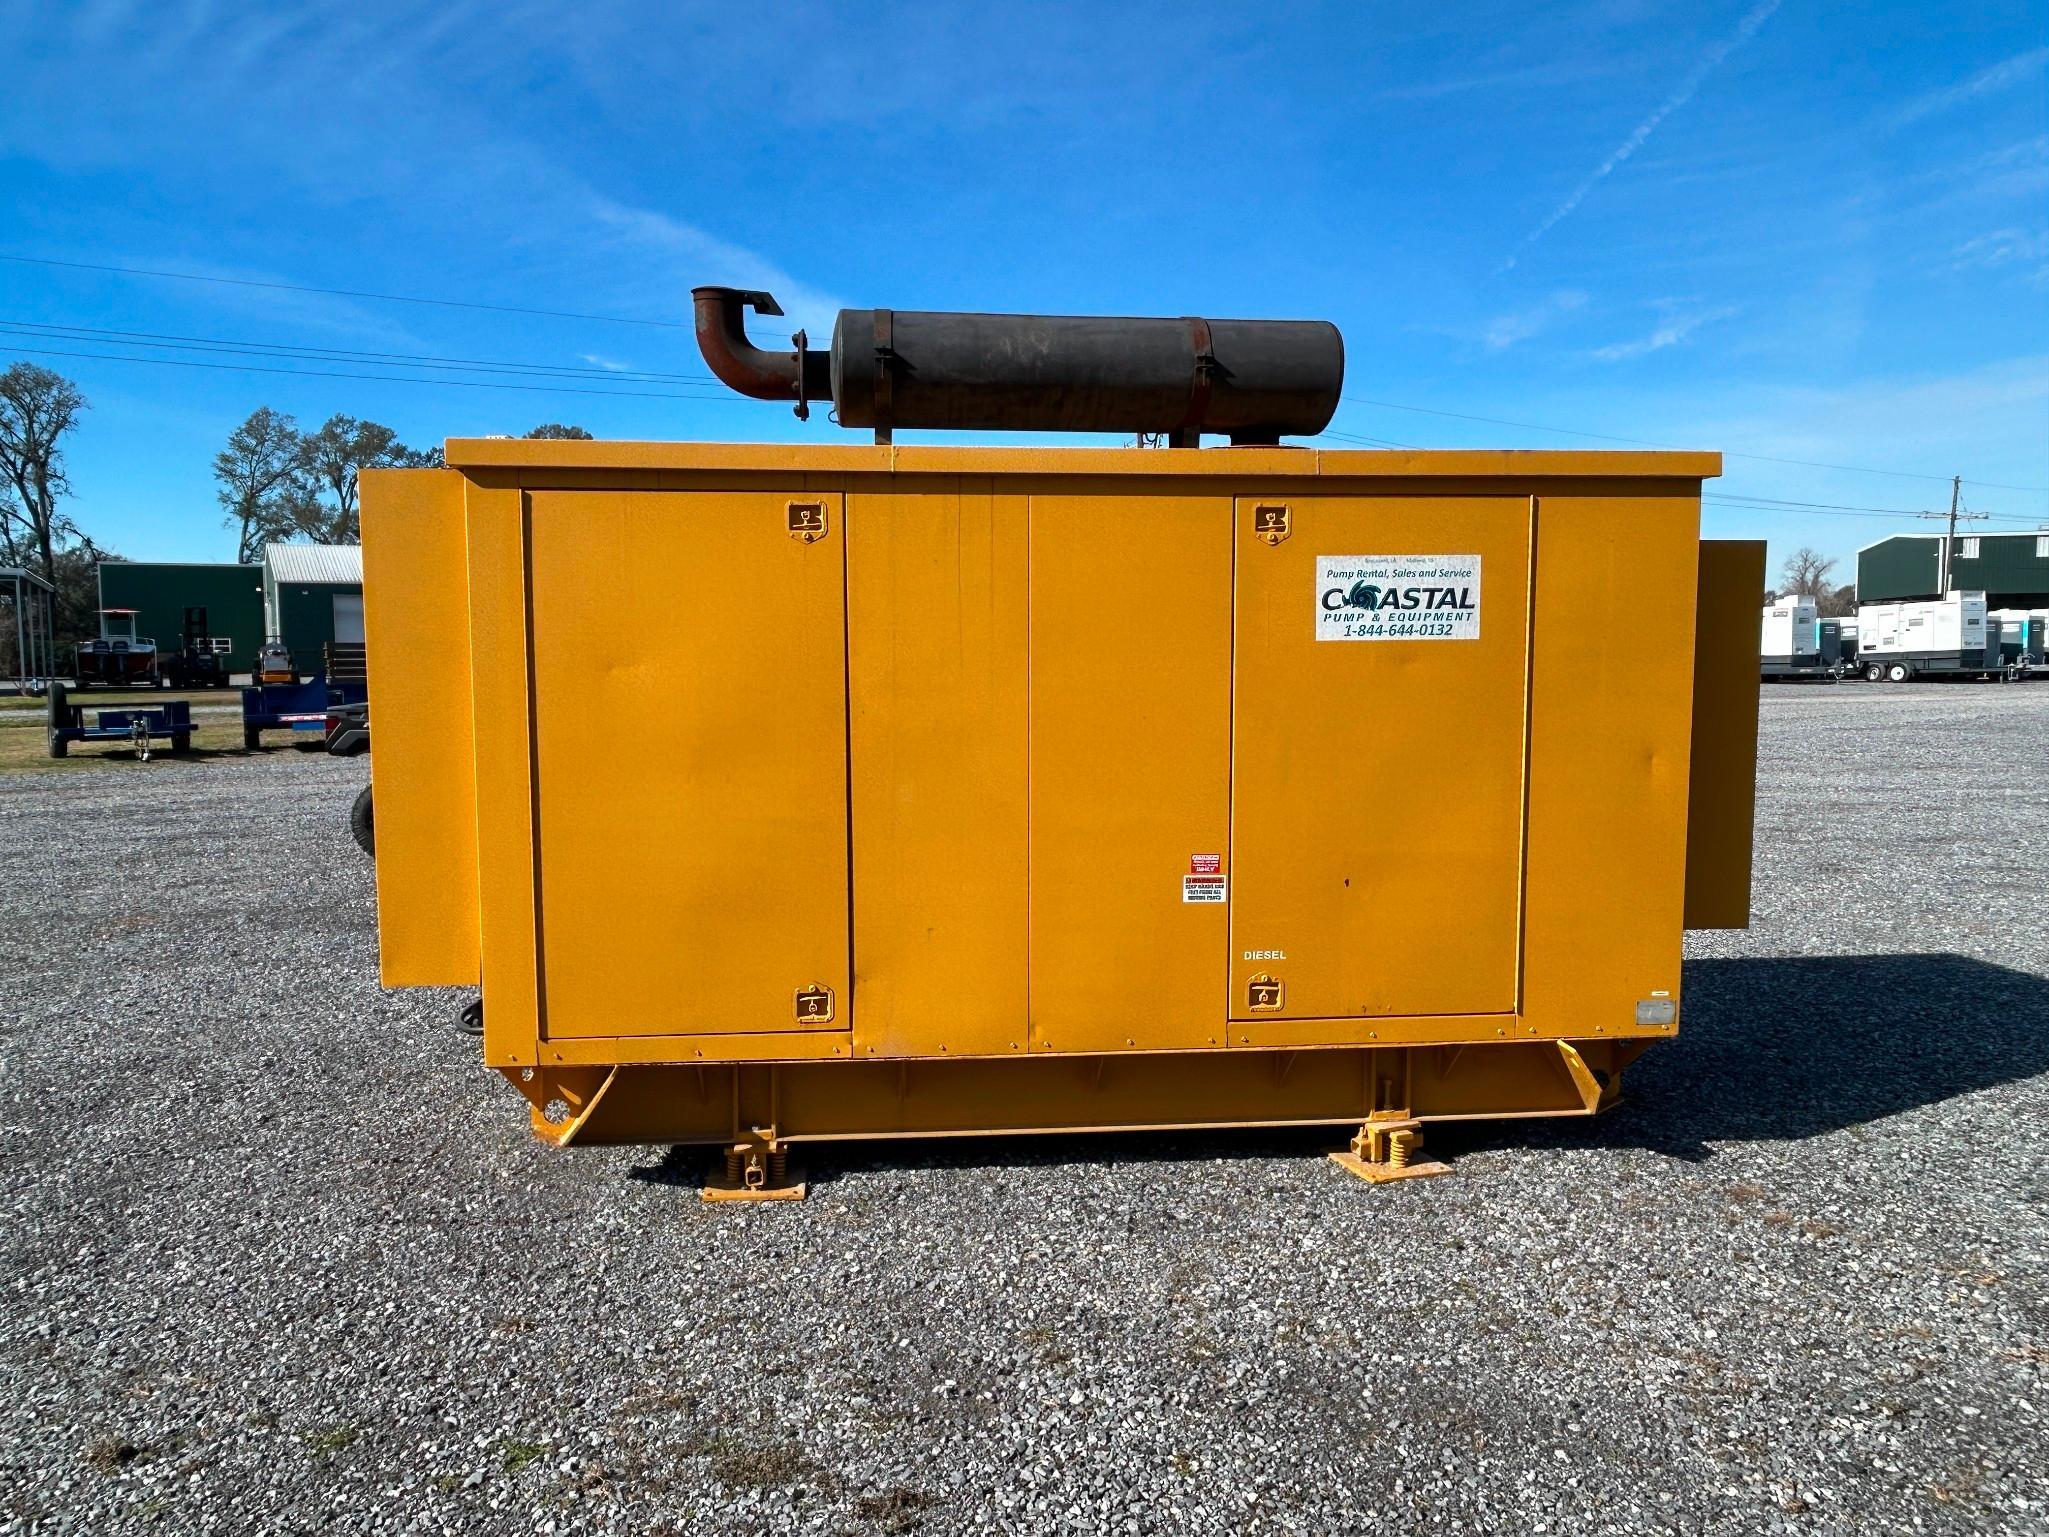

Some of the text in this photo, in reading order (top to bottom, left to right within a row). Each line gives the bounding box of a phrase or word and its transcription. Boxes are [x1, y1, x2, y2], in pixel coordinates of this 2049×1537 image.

[1327, 568, 1472, 580] Pump Rental, Sales and Service
[1321, 583, 1475, 611] COASTAL
[1323, 612, 1474, 622] PUMP & EQUIPMENT
[1343, 624, 1453, 637] 1-844-644-0132
[1244, 951, 1286, 960] DIESEL
